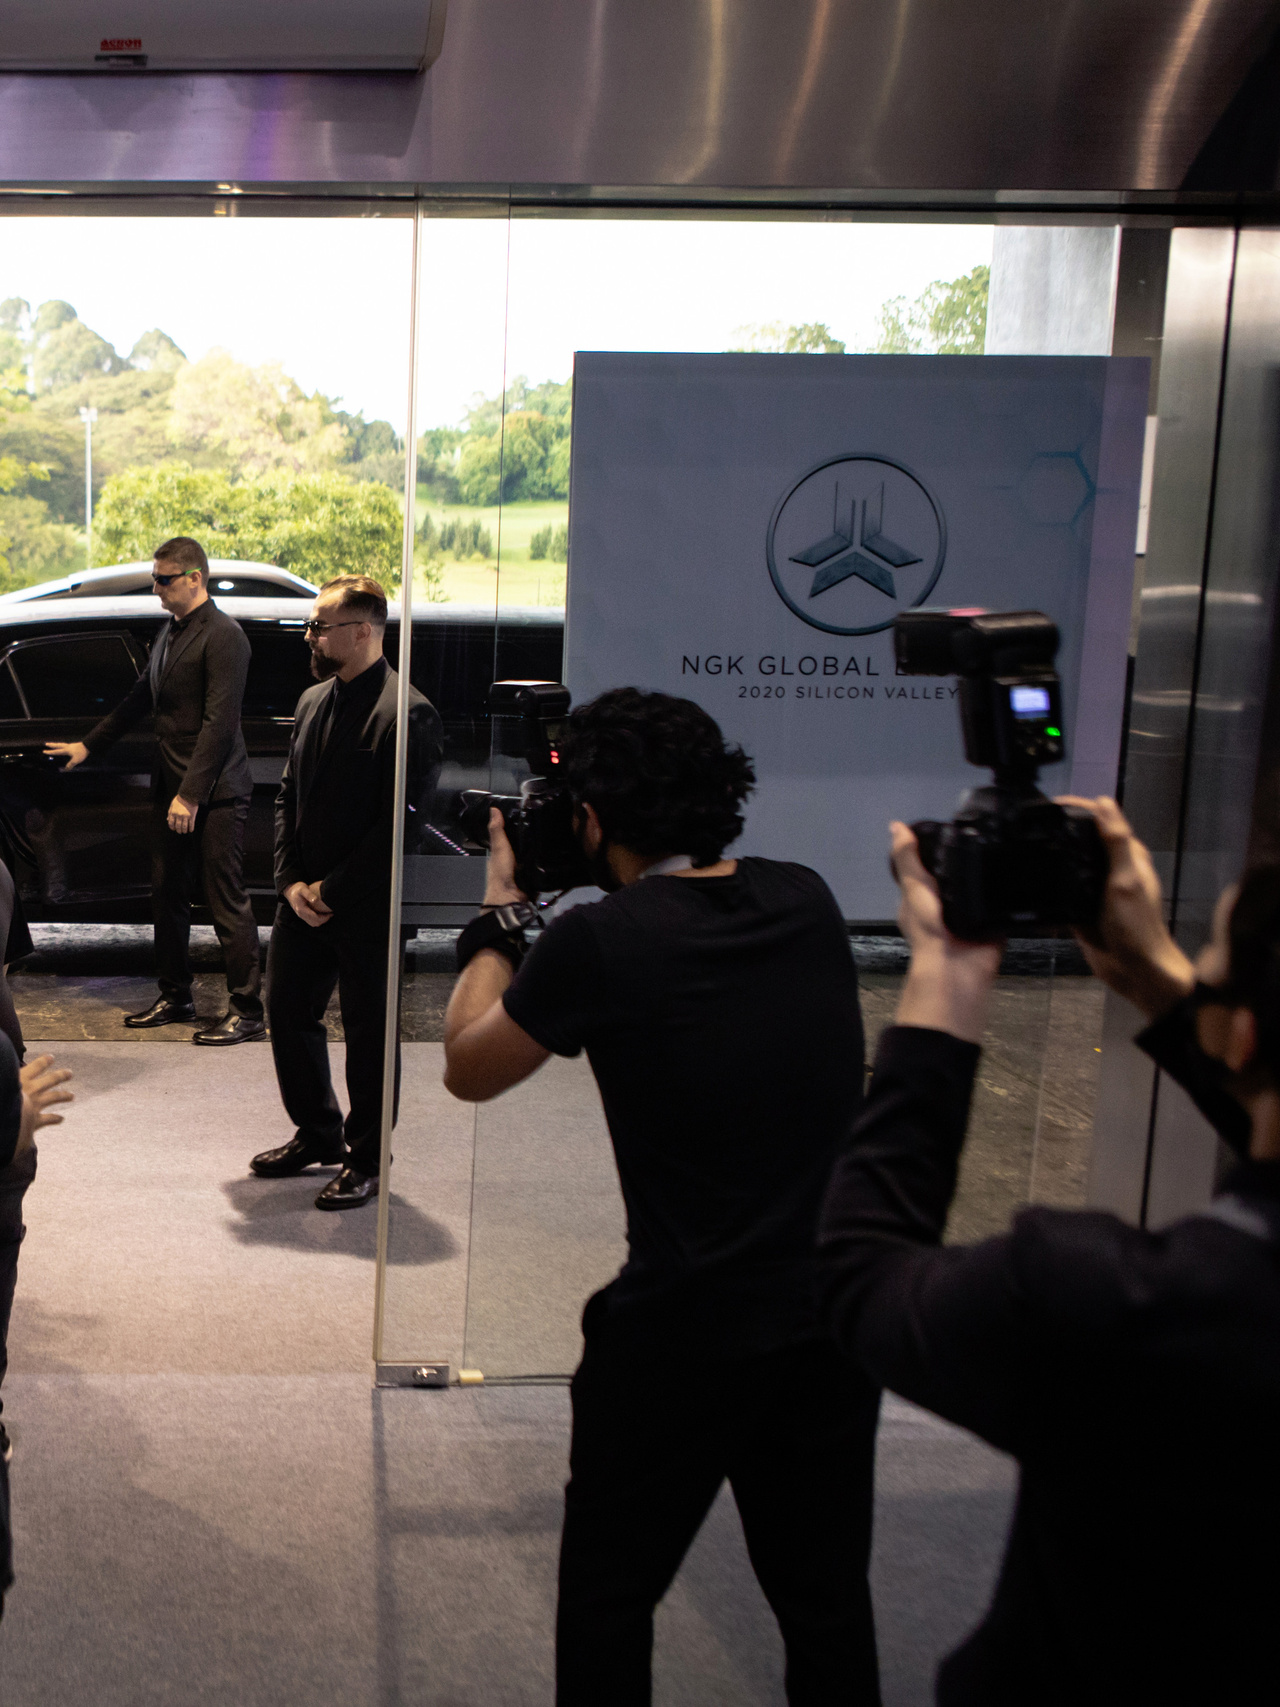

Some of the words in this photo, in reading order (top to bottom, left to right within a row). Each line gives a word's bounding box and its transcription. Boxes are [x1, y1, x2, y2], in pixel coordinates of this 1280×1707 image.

[682, 655, 744, 675] NGK
[758, 656, 879, 676] GLOBAL
[738, 686, 786, 699] 2020
[796, 686, 874, 699] SILICON
[885, 686, 959, 700] VALLEY
